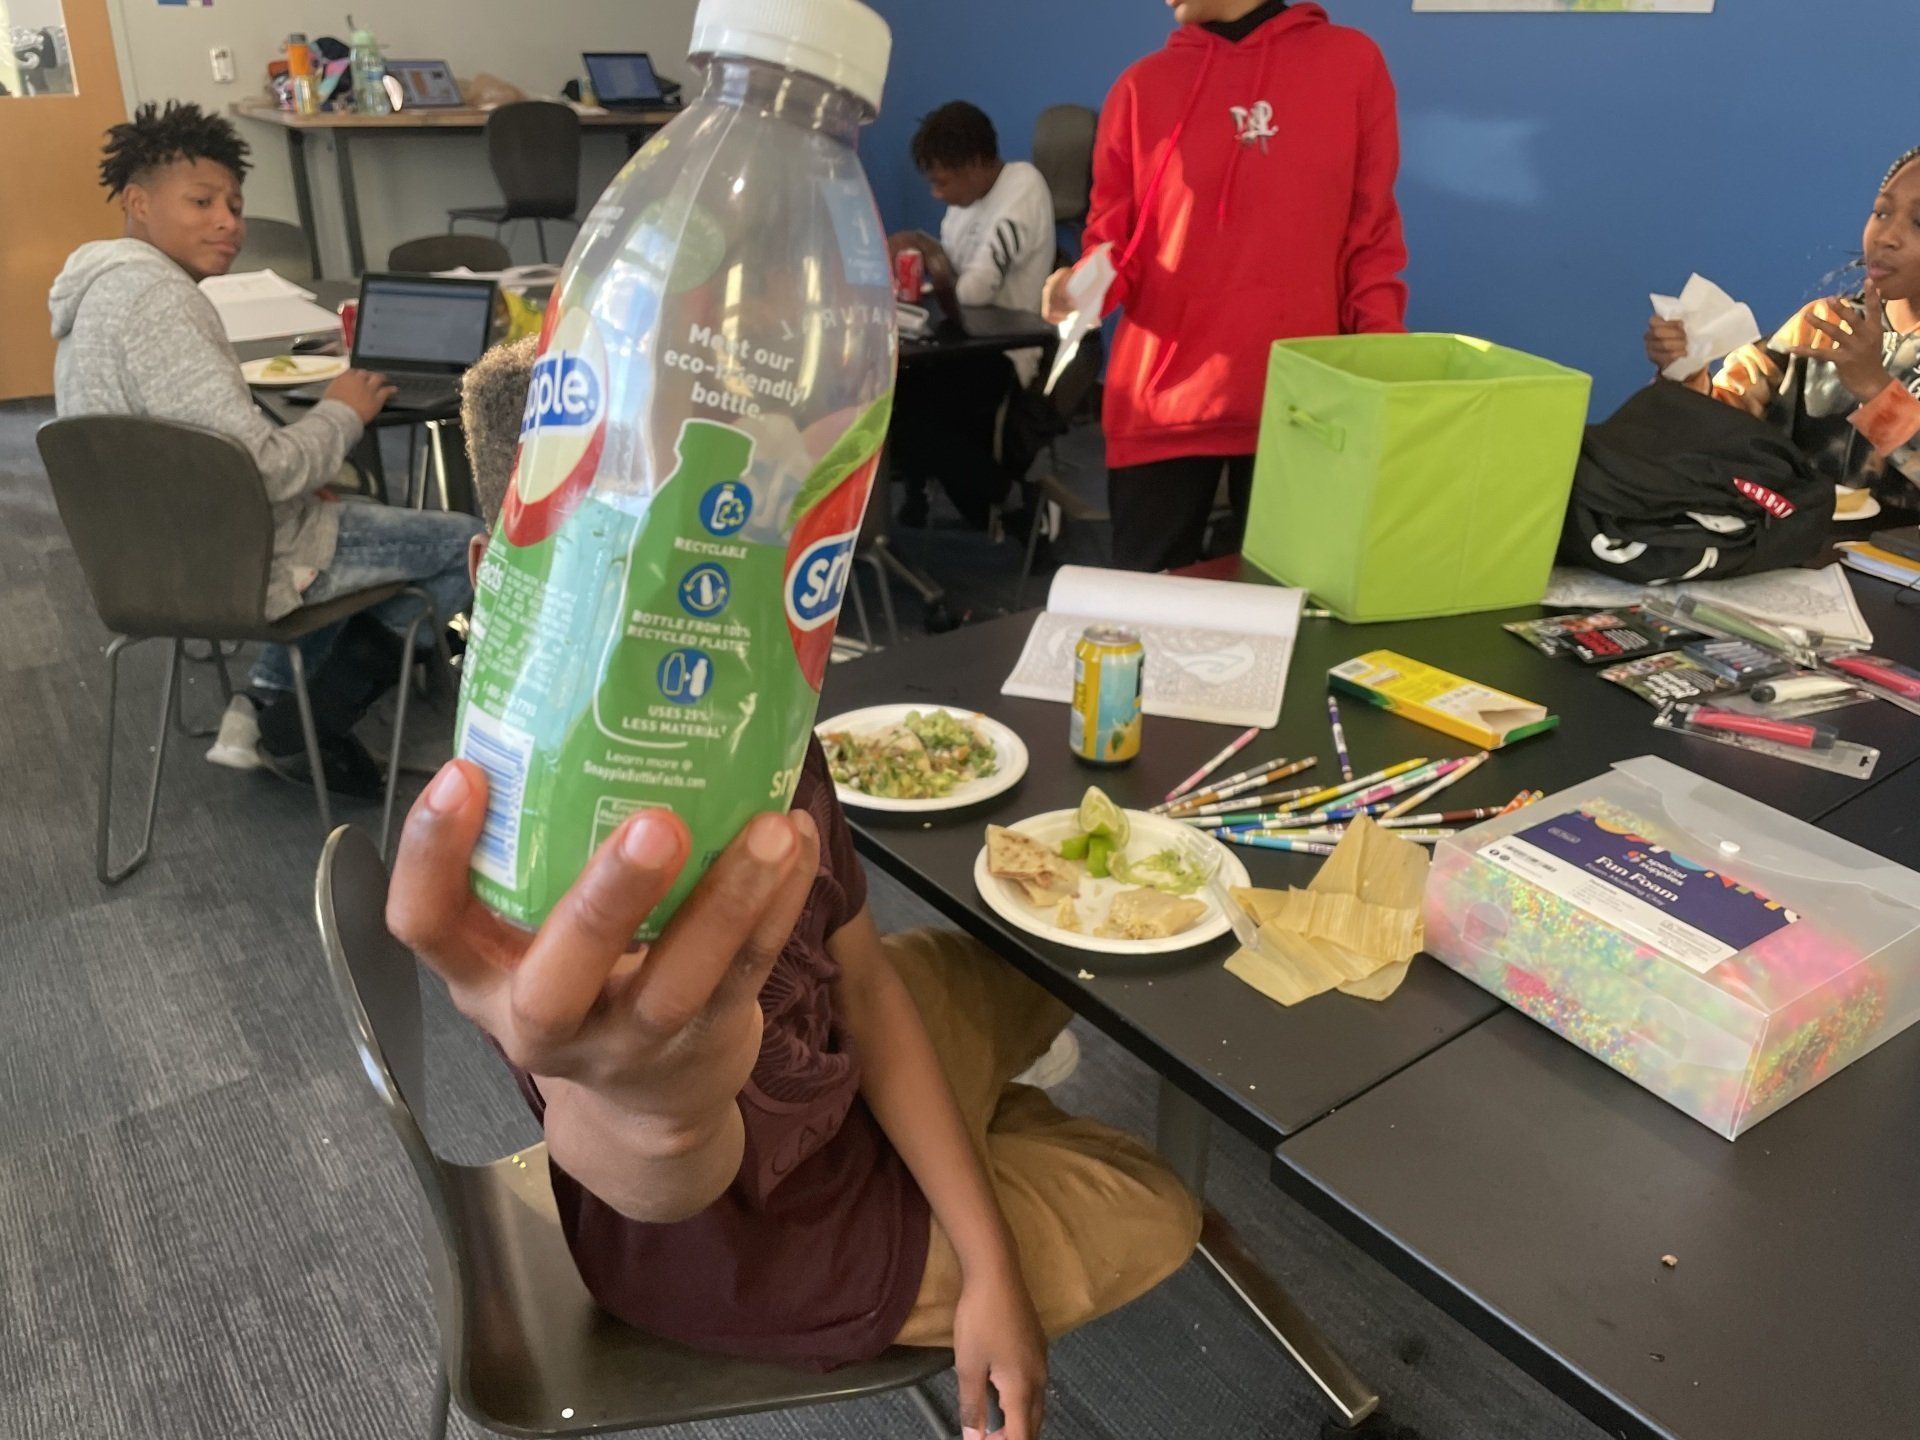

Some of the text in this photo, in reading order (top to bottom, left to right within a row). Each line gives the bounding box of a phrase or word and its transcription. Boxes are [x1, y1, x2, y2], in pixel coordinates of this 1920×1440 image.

[688, 322, 795, 372] Meet our
[690, 380, 766, 421] bottle.
[674, 536, 748, 559] RECYCLABLE
[632, 608, 685, 630] BOTTLE
[686, 619, 722, 635] FROM
[626, 624, 698, 646] RECYCLED
[647, 704, 682, 720] USES
[621, 715, 658, 733] LESS
[604, 749, 644, 766] Learn
[645, 756, 679, 771] more
[1594, 855, 1630, 877] Fun
[1628, 872, 1679, 902] Foam
